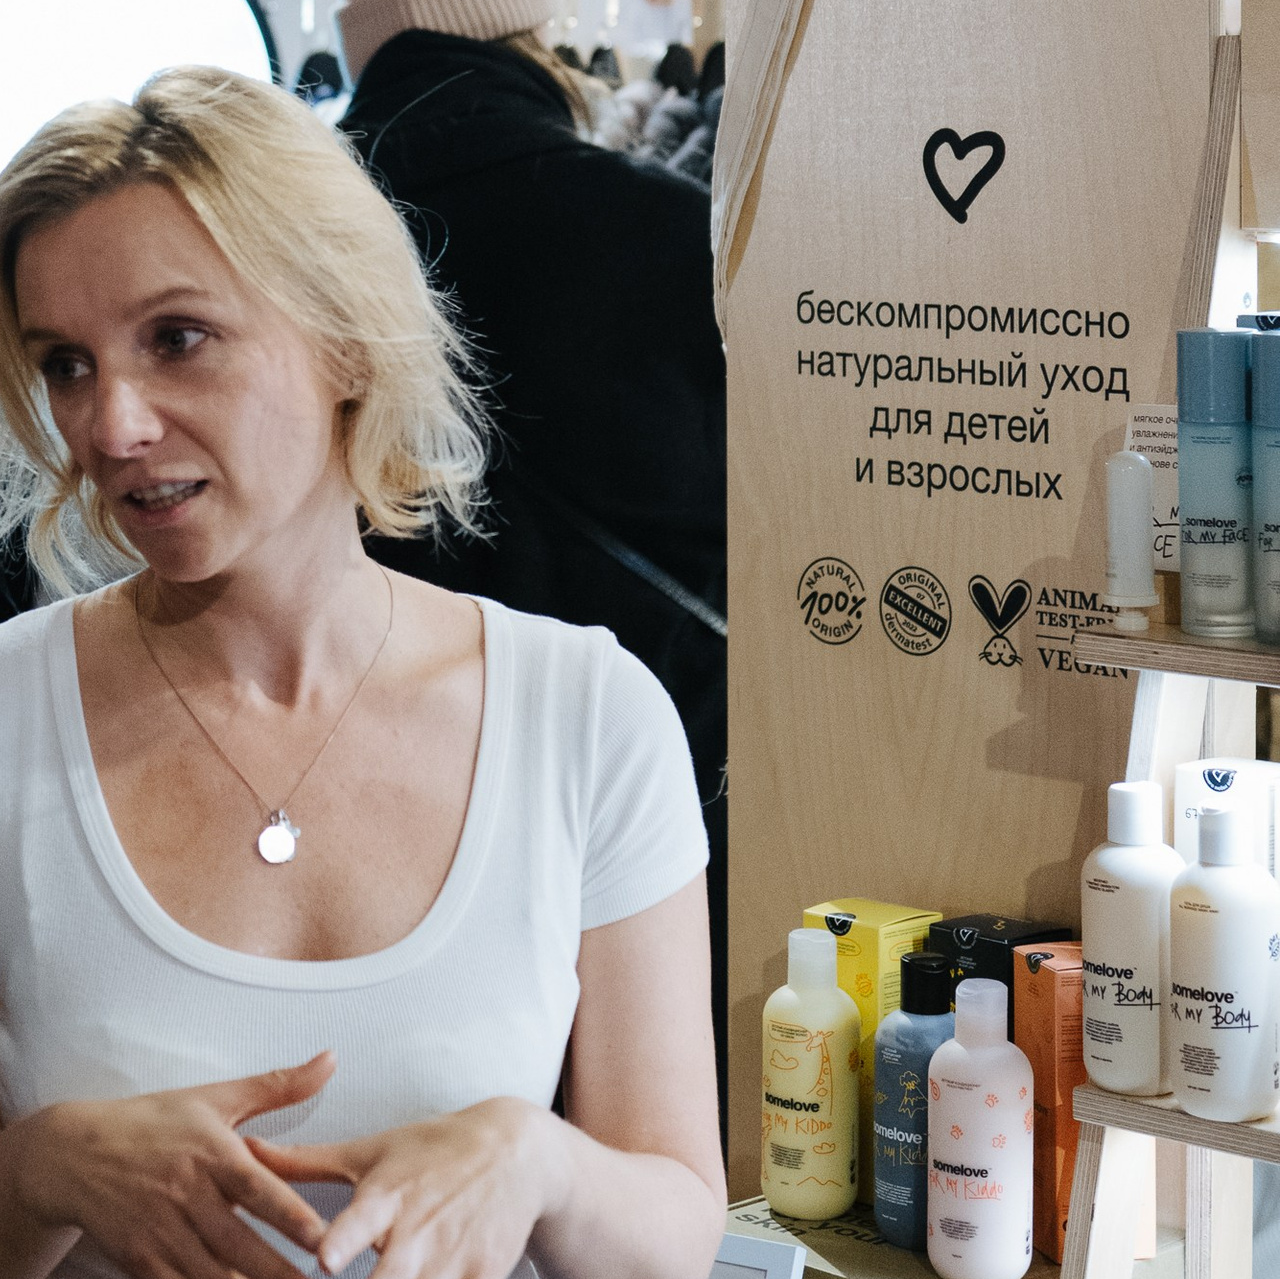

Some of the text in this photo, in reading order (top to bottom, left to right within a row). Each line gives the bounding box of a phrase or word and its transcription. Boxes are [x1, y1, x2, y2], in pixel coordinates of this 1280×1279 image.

[796, 290, 1131, 339] бескомпромиссно
[797, 349, 1131, 402] натуральный уход
[869, 406, 1050, 445] для детей
[1133, 414, 1164, 424] мягкое
[1131, 429, 1179, 439] увлажнени
[1136, 444, 1179, 455] антиэйдж
[1150, 460, 1170, 469] нове
[855, 457, 1064, 500] и взрослых
[1185, 517, 1238, 528] somelove
[1153, 534, 1177, 558] CE
[805, 564, 857, 593] NATURAL
[897, 572, 946, 610] ORIGINAL
[1036, 587, 1121, 614] ANIM
[800, 591, 867, 625] 100%
[888, 589, 944, 633] EXCELLENT
[812, 617, 854, 638] ORIGIN
[884, 612, 933, 651] dermatest
[902, 619, 918, 633] 2022
[1082, 960, 1134, 979] omelove
[1091, 984, 1107, 999] MY
[1185, 1007, 1203, 1023] MY
[933, 1158, 989, 1179] somelove
